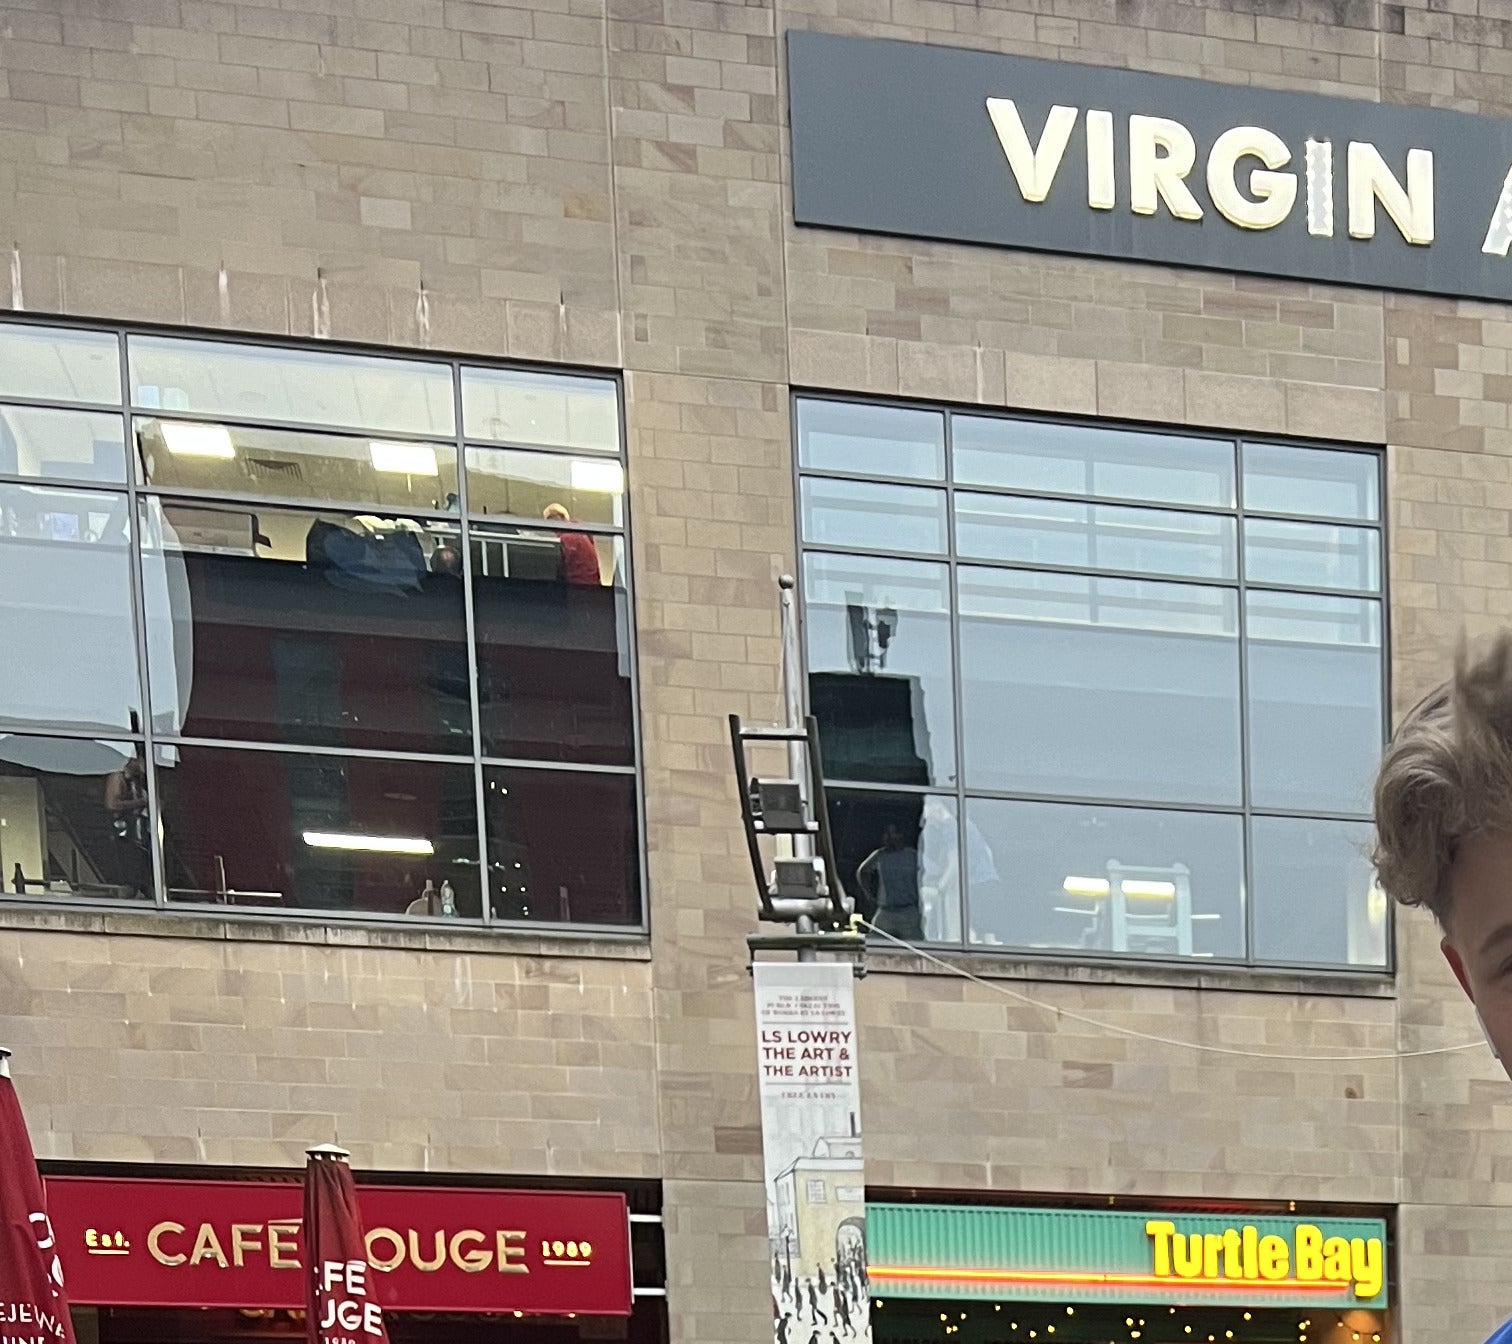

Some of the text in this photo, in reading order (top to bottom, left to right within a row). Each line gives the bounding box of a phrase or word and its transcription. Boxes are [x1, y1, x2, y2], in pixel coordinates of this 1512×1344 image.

[985, 96, 1436, 246] VIRGIN
[761, 1030, 852, 1044] LS LOWRY
[762, 1047, 850, 1060] THE ART &
[763, 1065, 853, 1077] THE ARTIST
[84, 1228, 130, 1247] Est.
[146, 1218, 304, 1269] CAFÉ
[363, 1226, 530, 1274] OUGE
[541, 1240, 592, 1258] 1989
[1145, 1220, 1383, 1298] Turtle Bay
